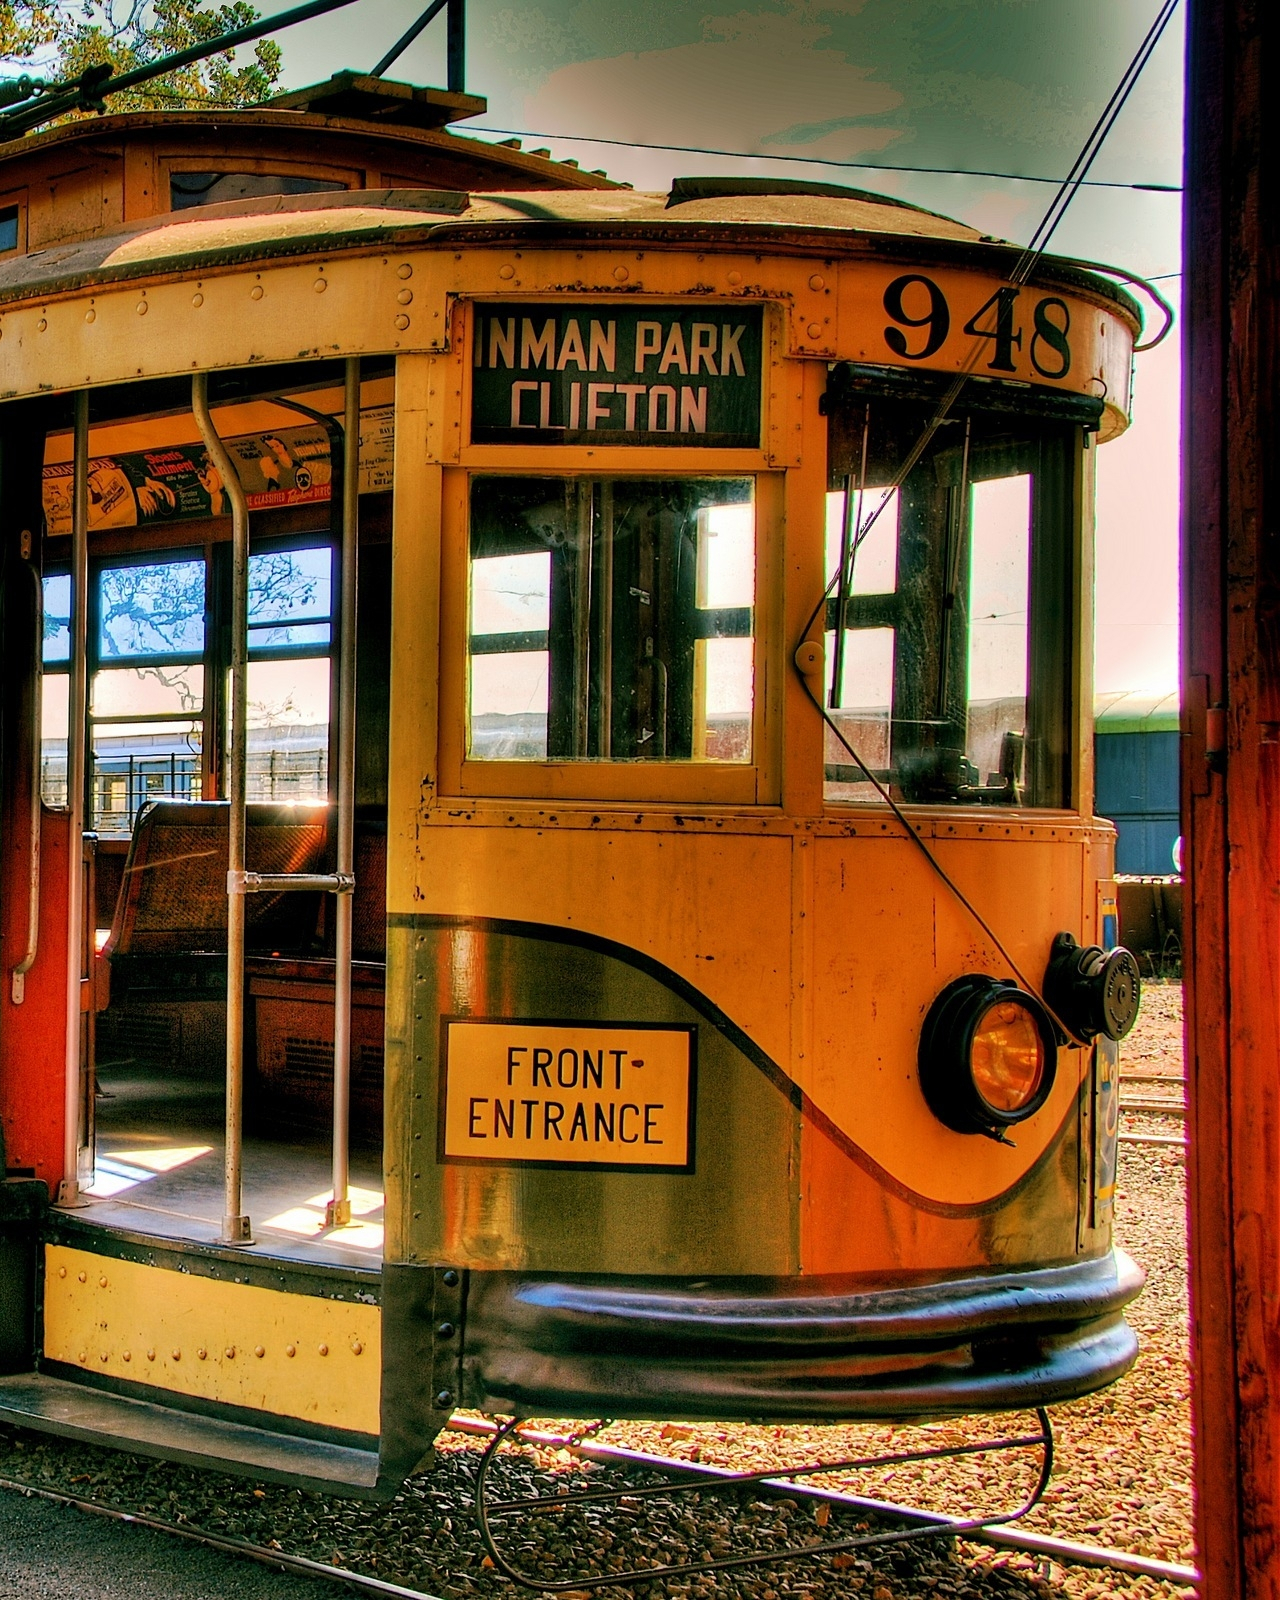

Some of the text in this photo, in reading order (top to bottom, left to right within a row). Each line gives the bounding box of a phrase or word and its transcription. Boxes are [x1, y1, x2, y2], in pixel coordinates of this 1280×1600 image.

[473, 316, 746, 377] INMAN PARK
[883, 274, 1070, 379] 948
[510, 380, 708, 433] CLIFTON
[147, 459, 196, 477] Liniment
[254, 492, 286, 505] CLASSIFIED
[469, 1098, 664, 1144] ENTRANCE
